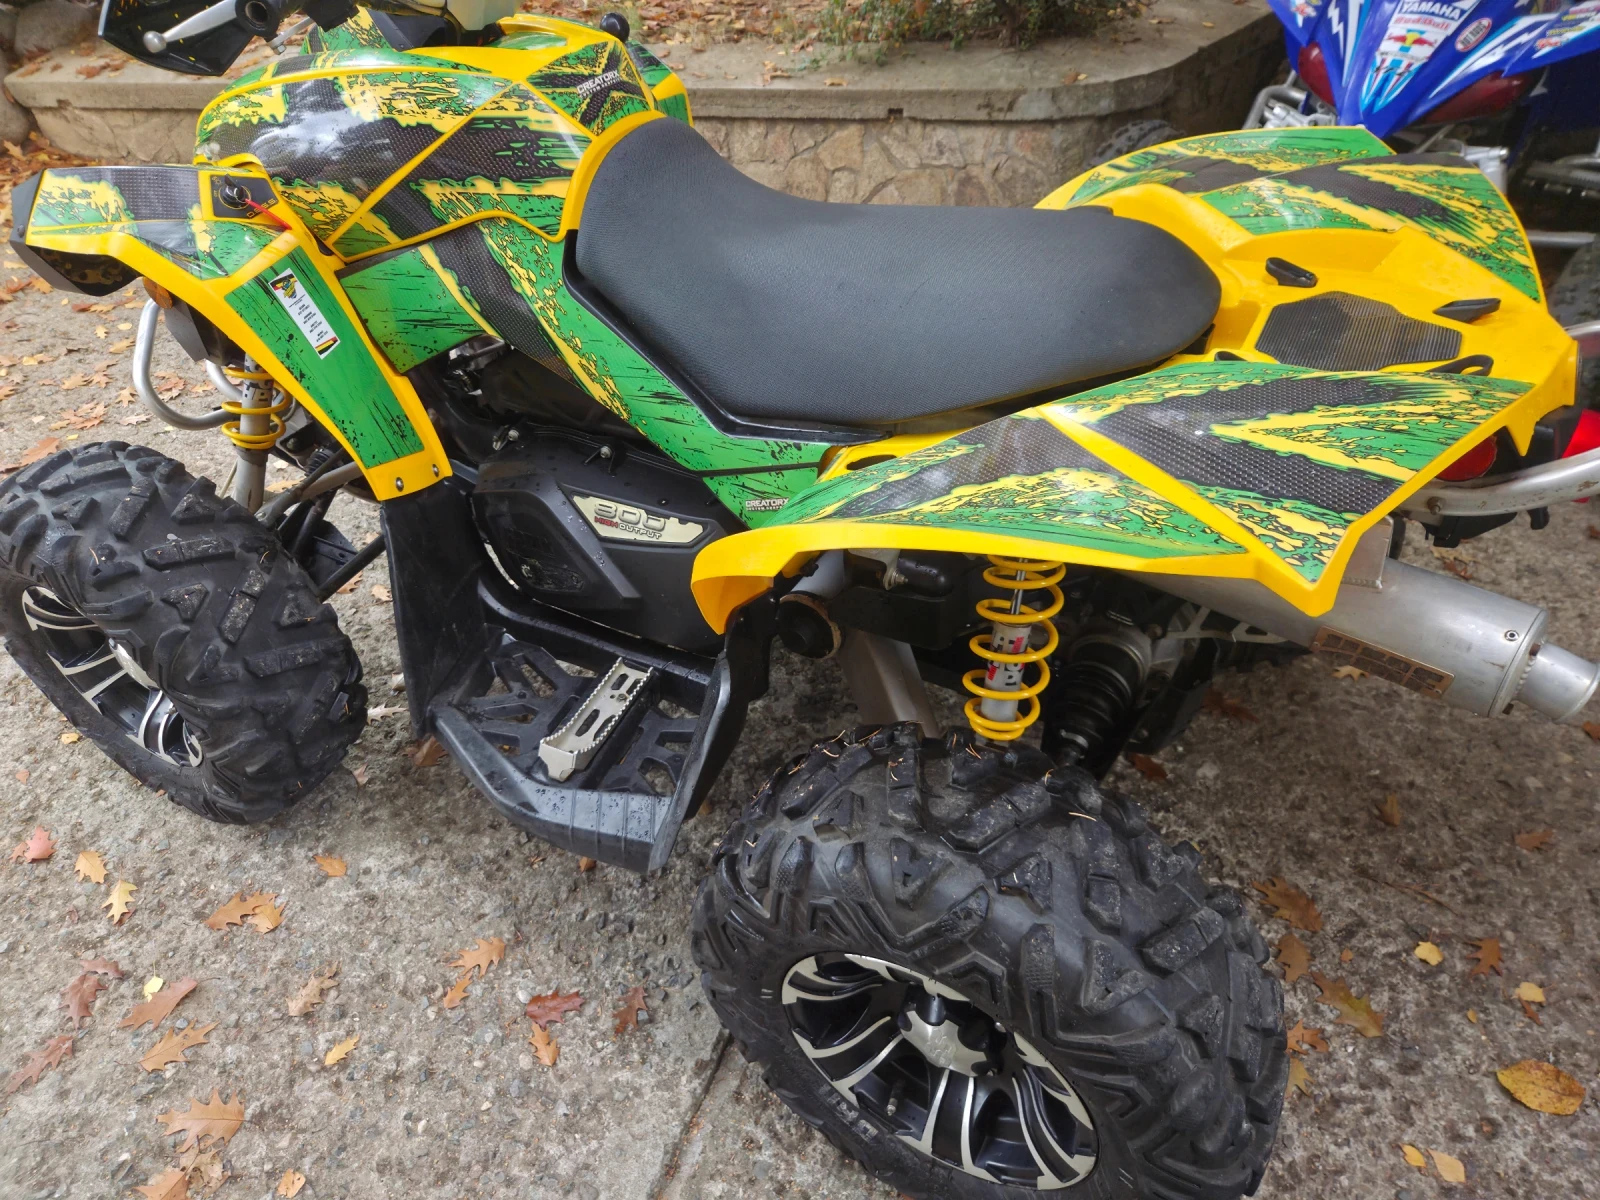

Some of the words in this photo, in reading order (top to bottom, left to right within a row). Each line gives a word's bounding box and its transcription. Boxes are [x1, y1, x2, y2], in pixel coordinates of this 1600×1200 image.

[1401, 0, 1461, 20] YAMAHA
[594, 502, 666, 532] 800
[594, 516, 619, 528] HIGH
[619, 523, 662, 539] OUTPUT
